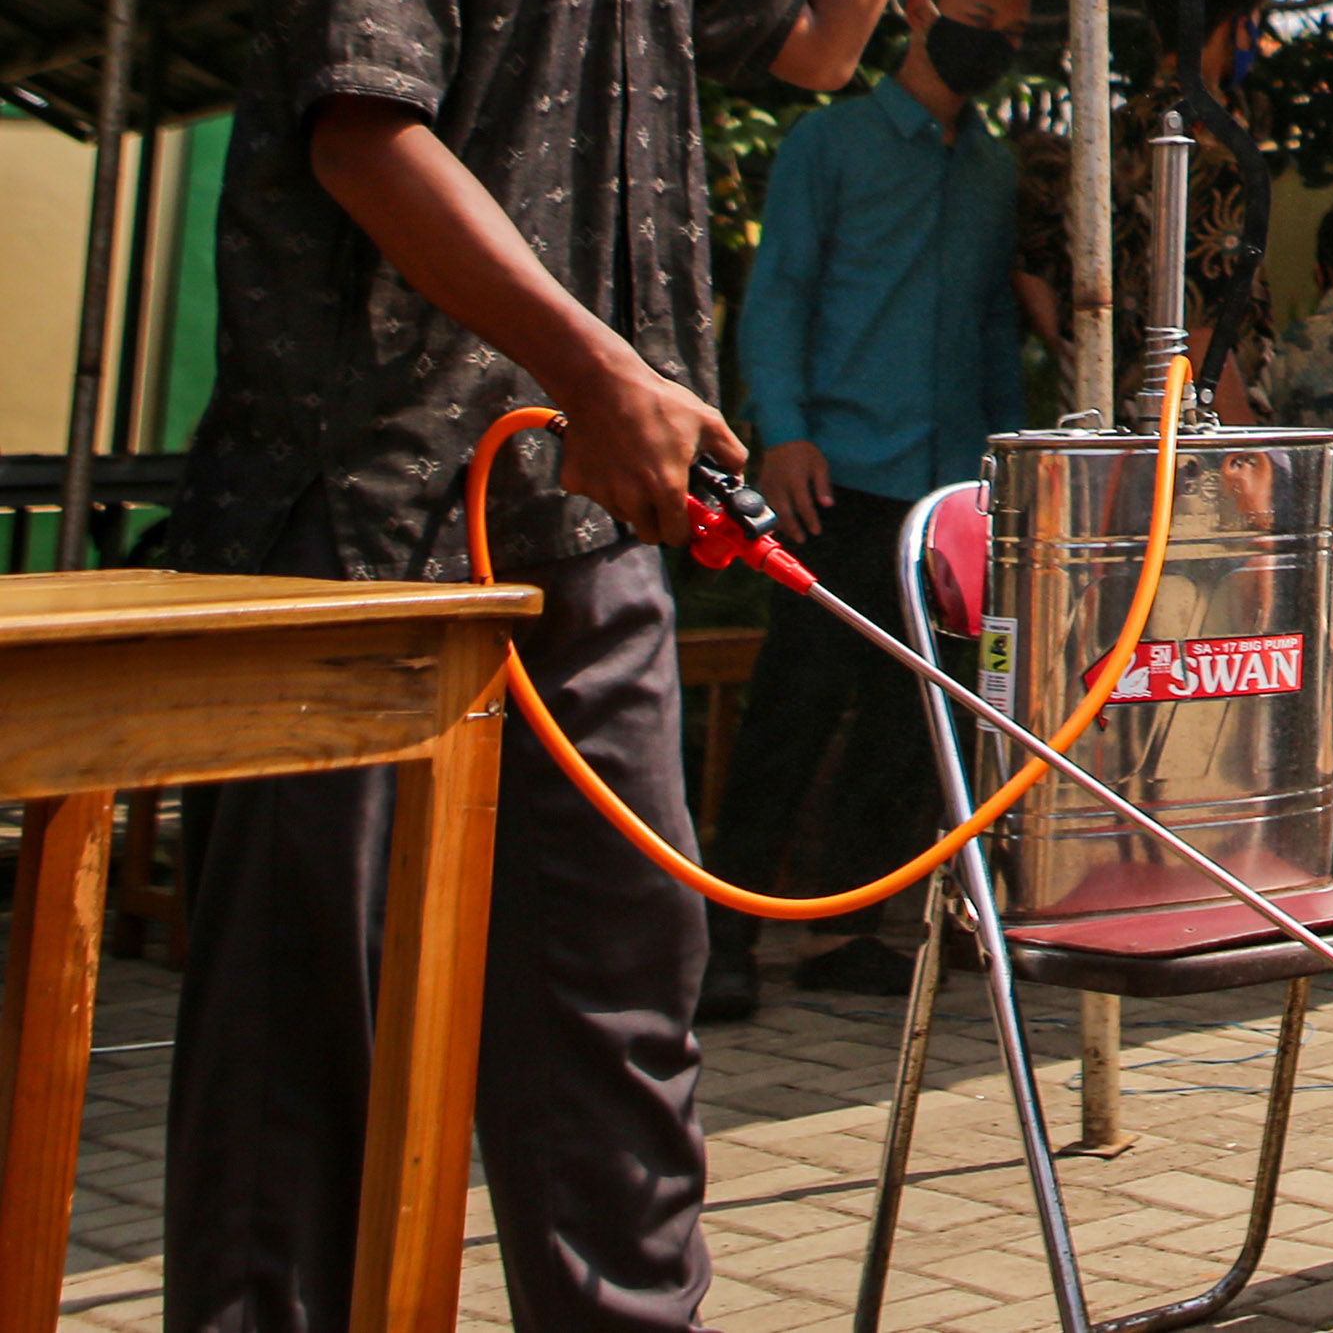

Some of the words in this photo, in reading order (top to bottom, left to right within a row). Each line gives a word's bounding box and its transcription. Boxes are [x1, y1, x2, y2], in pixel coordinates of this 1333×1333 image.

[1192, 643, 1212, 655] SA
[1222, 642, 1237, 653] 17
[1239, 640, 1262, 653] BIG
[1264, 637, 1298, 651] PUMP
[1168, 651, 1300, 696] SWAN
